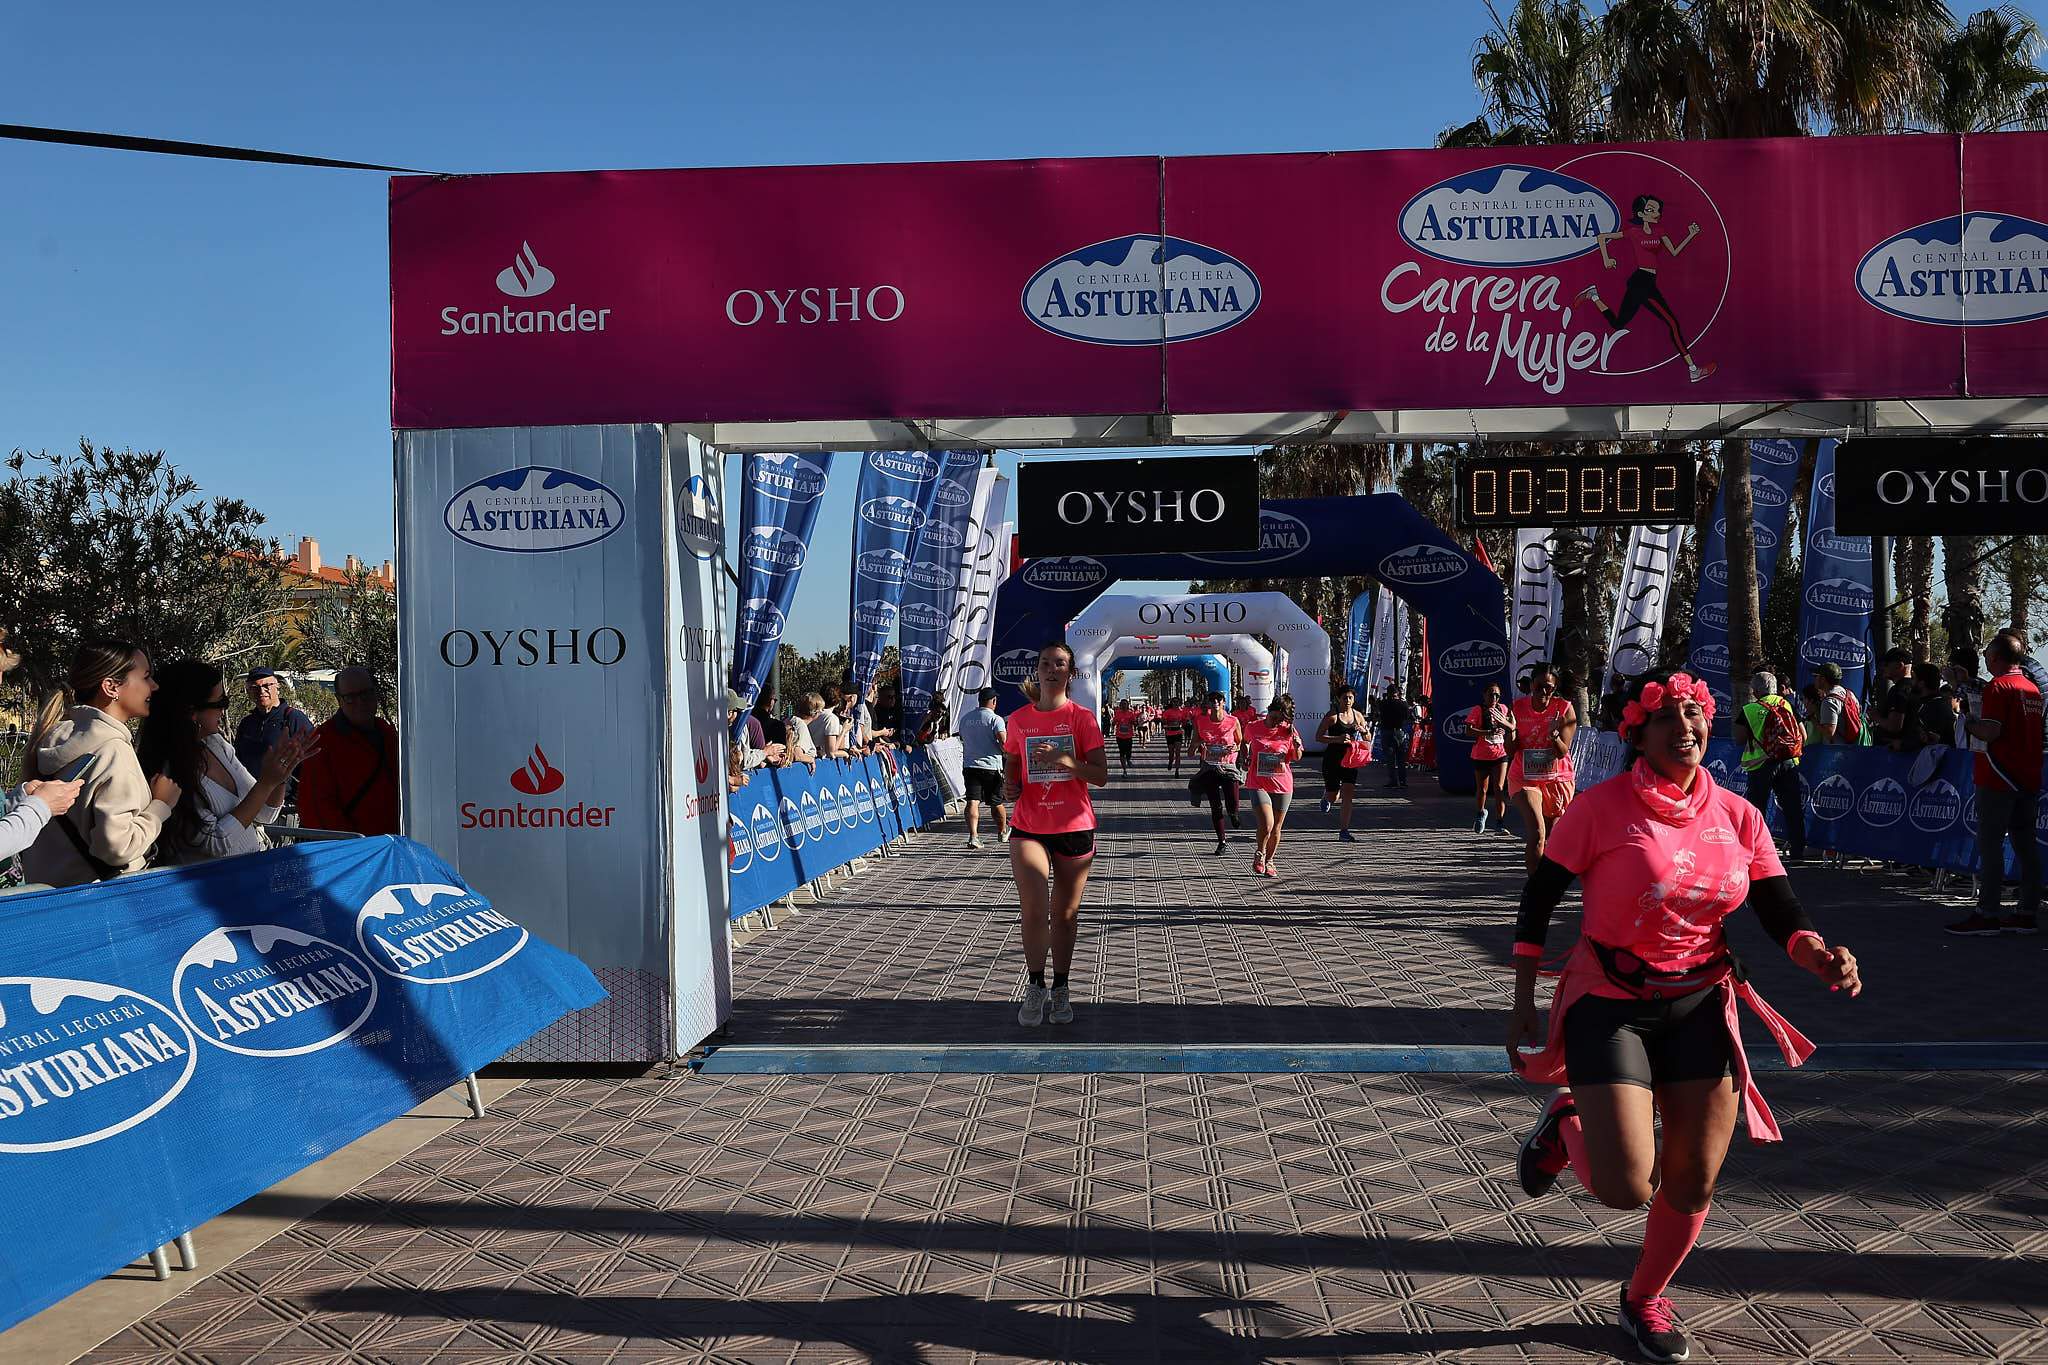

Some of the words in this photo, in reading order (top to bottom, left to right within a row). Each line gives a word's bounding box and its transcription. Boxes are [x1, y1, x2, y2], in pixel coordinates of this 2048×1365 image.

[1448, 199, 1518, 212] CENTRAL
[1525, 198, 1596, 210] LECHERA
[1415, 204, 1602, 242] ASTURIANA
[1912, 251, 1989, 264] CENTRAL
[1076, 272, 1152, 286] CENTRAL
[1158, 269, 1235, 283] ECHERA
[1380, 261, 1561, 314] Carrera
[725, 285, 906, 327] OYSHO
[1040, 277, 1243, 319] ASTURIANA
[441, 303, 612, 336] Santander
[1424, 315, 1459, 353] de
[1465, 314, 1490, 353] la
[1484, 306, 1632, 395] Mujer
[486, 496, 542, 506] CENTRAL
[548, 495, 605, 504] LECHERA
[1472, 465, 1679, 515] 00:38:02
[1876, 468, 2048, 505] OYSHO
[457, 499, 612, 532] ASTURIANA
[1056, 487, 1225, 526] OYSHO
[1028, 567, 1101, 582] ASTURIANA
[1387, 561, 1463, 576] ASTURIANA
[1138, 601, 1247, 625] OYSHO
[1277, 622, 1312, 632] OYSHO
[440, 626, 627, 668] OYSHO
[1074, 628, 1108, 637] OYSHO
[1295, 667, 1326, 677] OYSHO
[1444, 654, 1504, 670] ASTURIANA
[461, 801, 616, 829] Santander
[387, 911, 439, 936] CENTRAL
[436, 898, 484, 918] LECHERA
[372, 908, 520, 973] ASTURIANA
[213, 963, 276, 991] CENTRAL
[275, 948, 334, 972] LECHERA
[194, 962, 370, 1041] ASTURIANA
[60, 1003, 145, 1037] LECHERA
[0, 1022, 187, 1121] STURIANA
